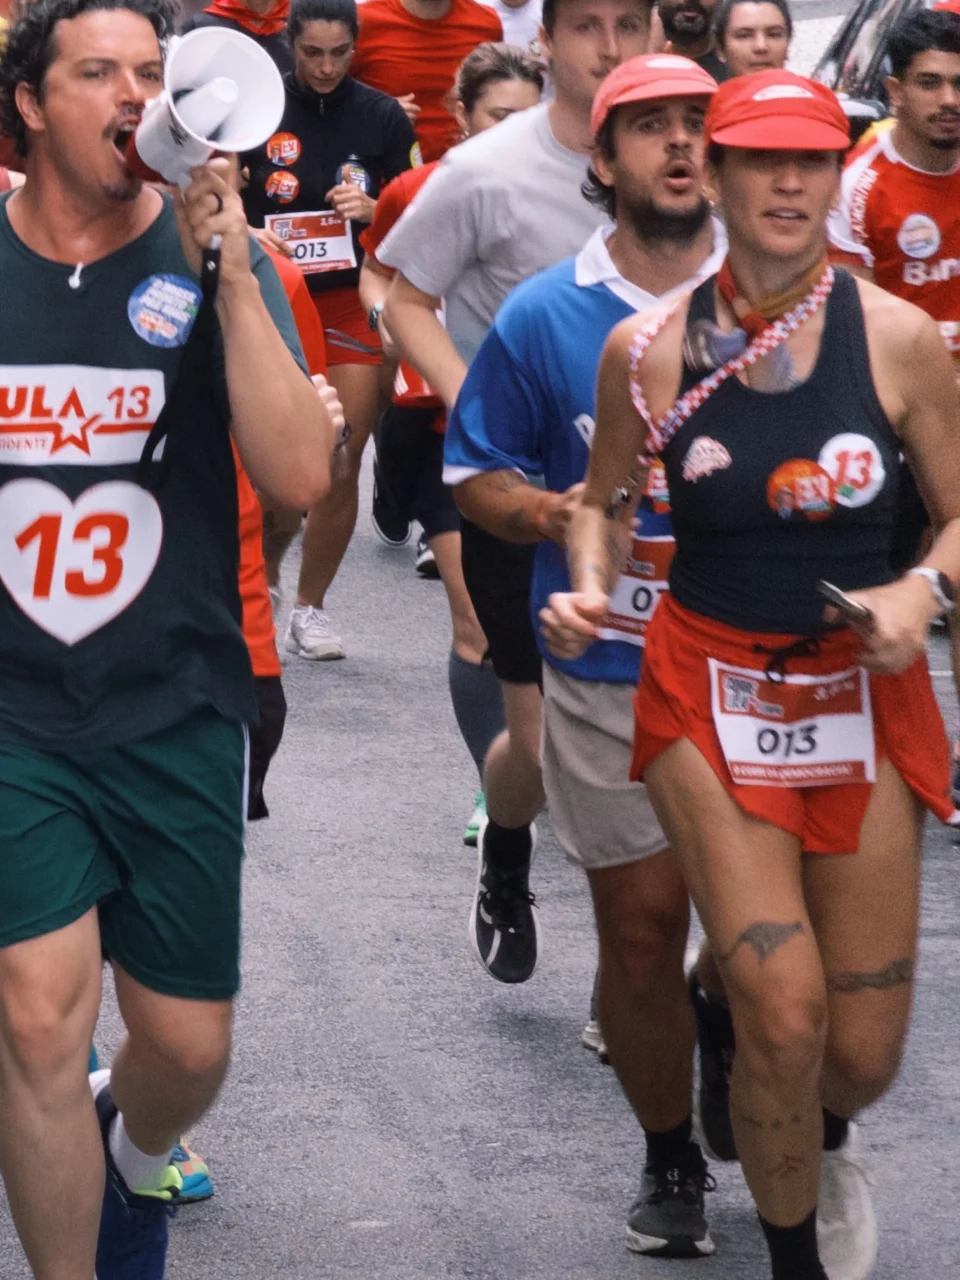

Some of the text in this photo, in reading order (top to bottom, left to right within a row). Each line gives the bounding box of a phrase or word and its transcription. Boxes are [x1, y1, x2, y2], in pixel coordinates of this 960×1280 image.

[294, 242, 327, 260] 013
[107, 385, 152, 420] 13
[835, 450, 873, 490] 13
[14, 513, 130, 599] 13
[757, 724, 818, 758] 013
